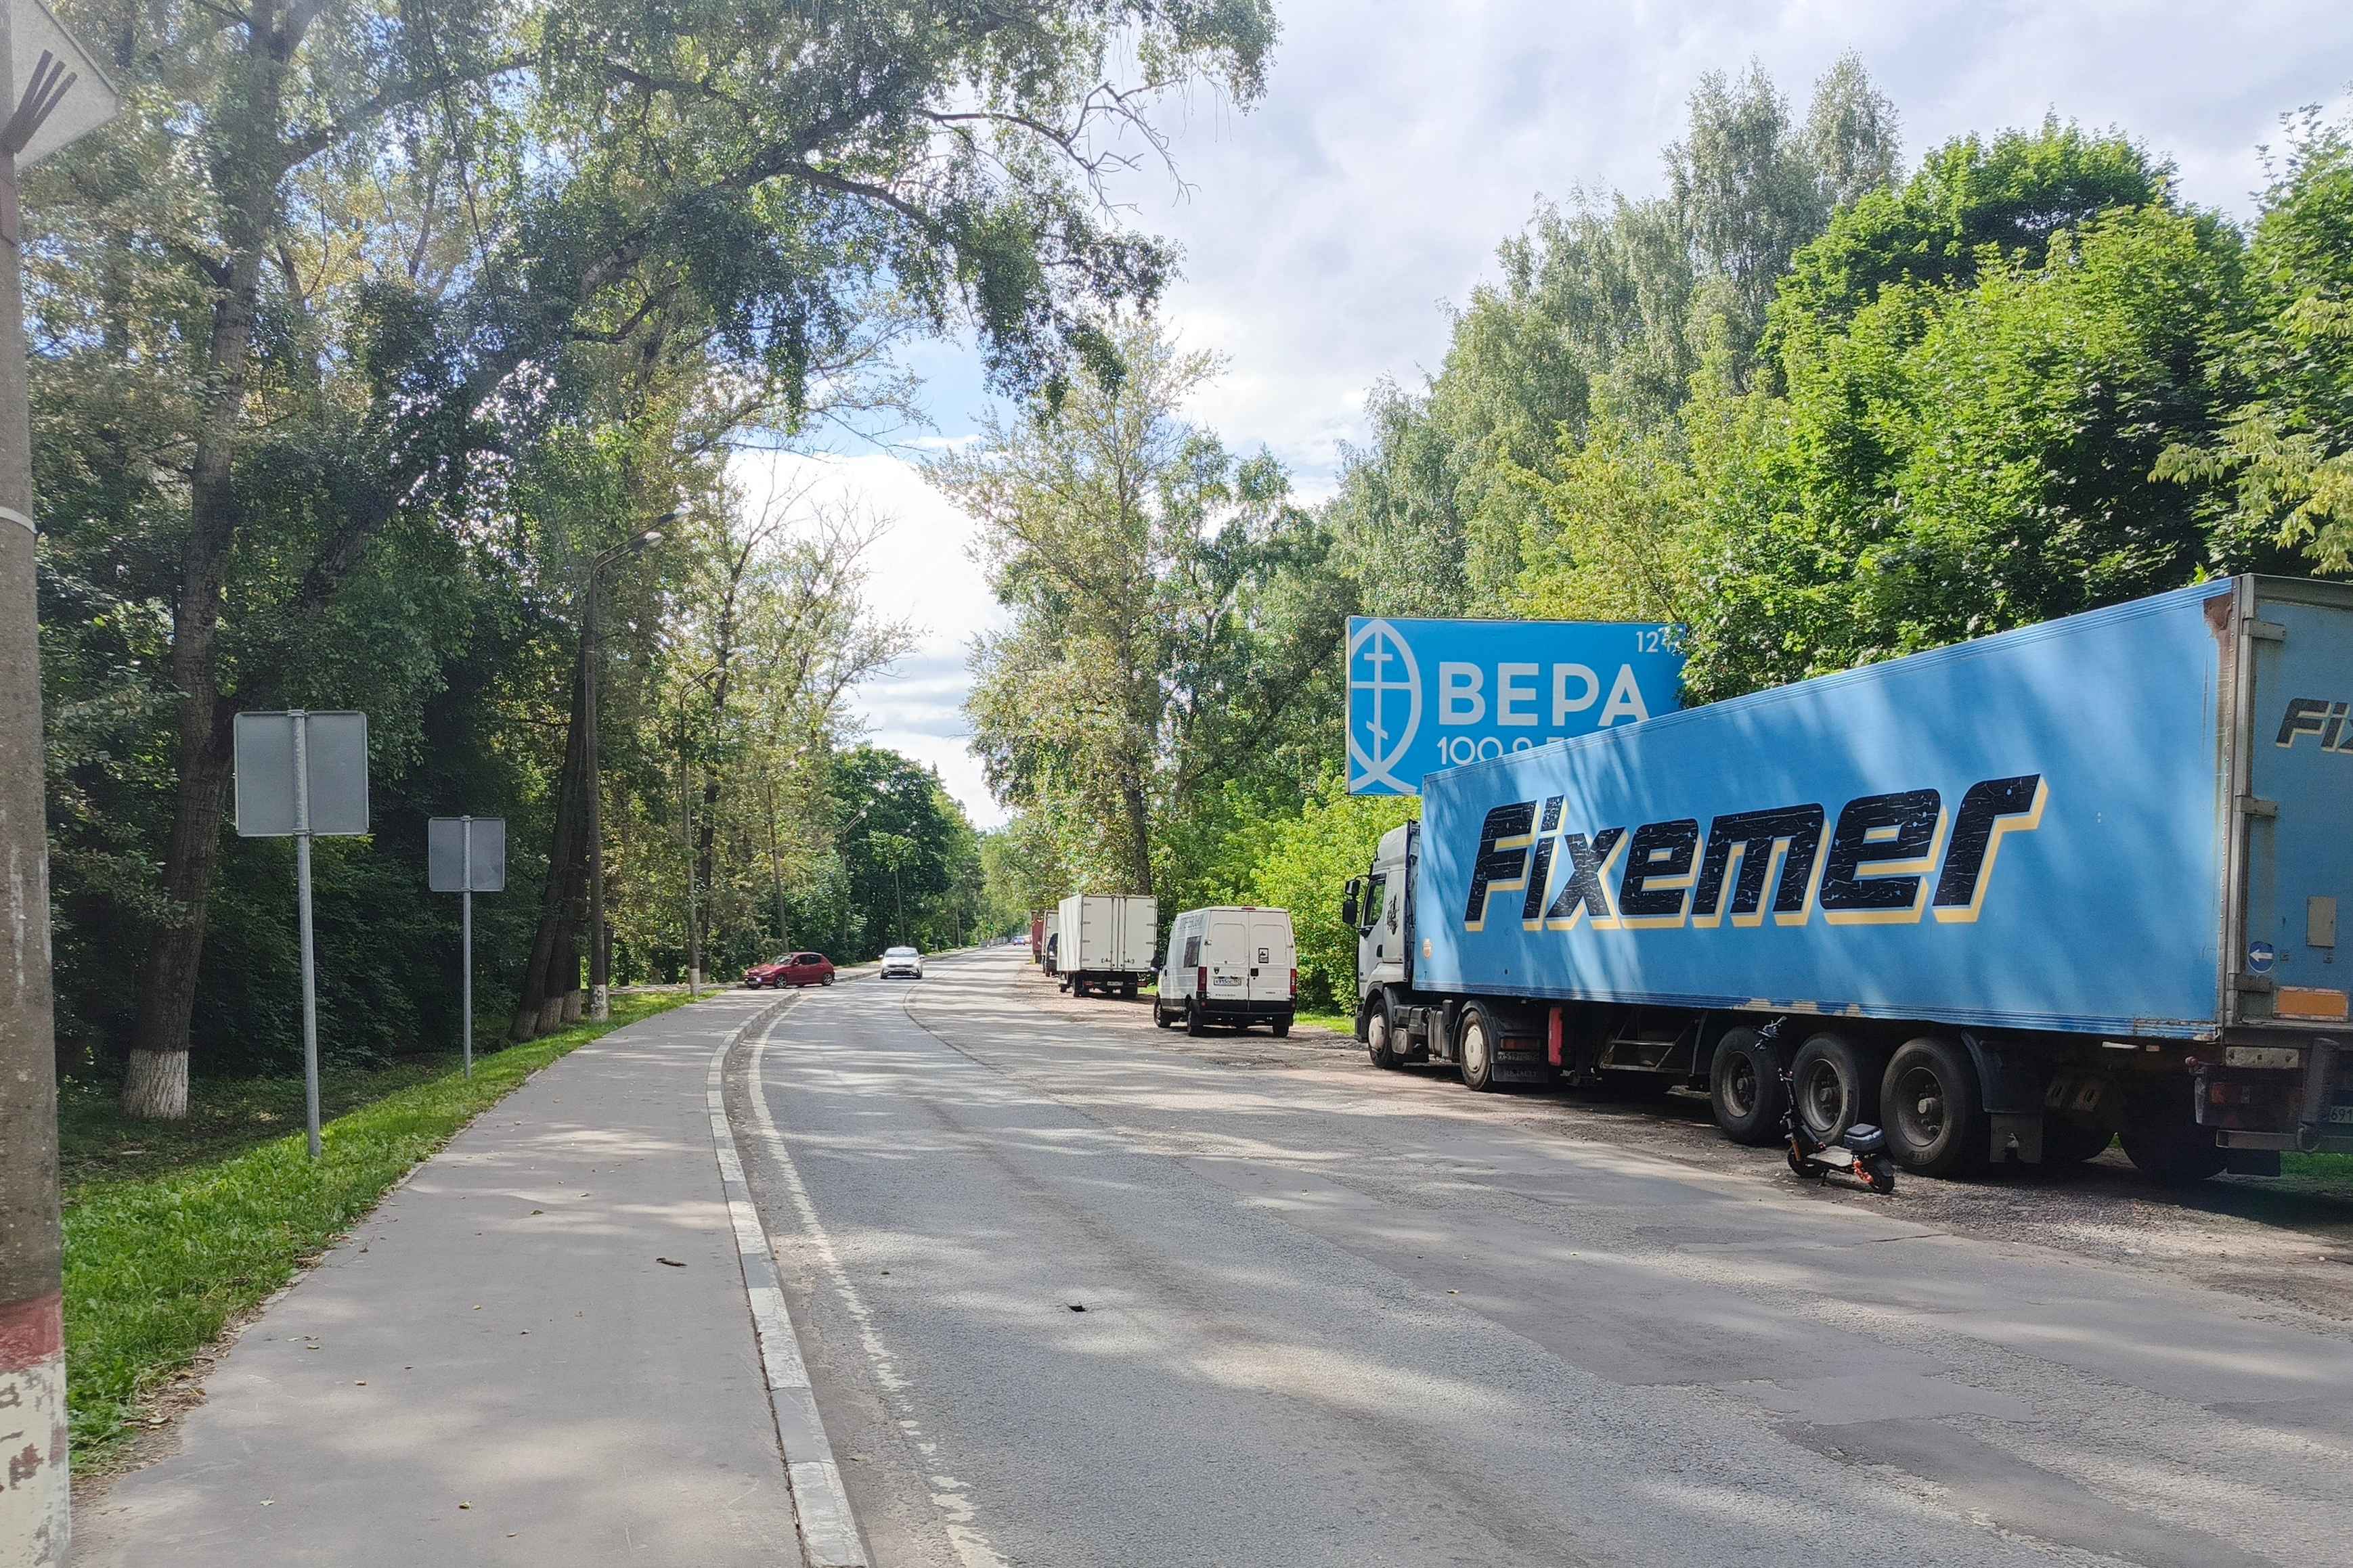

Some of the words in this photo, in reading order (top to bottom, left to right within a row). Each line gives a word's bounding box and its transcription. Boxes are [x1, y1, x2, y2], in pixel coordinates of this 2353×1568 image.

[1439, 661, 1650, 726] ВЕРА
[1437, 736, 1533, 766] 100
[2275, 698, 2353, 754] Fi
[1464, 774, 2049, 931] Fixemer
